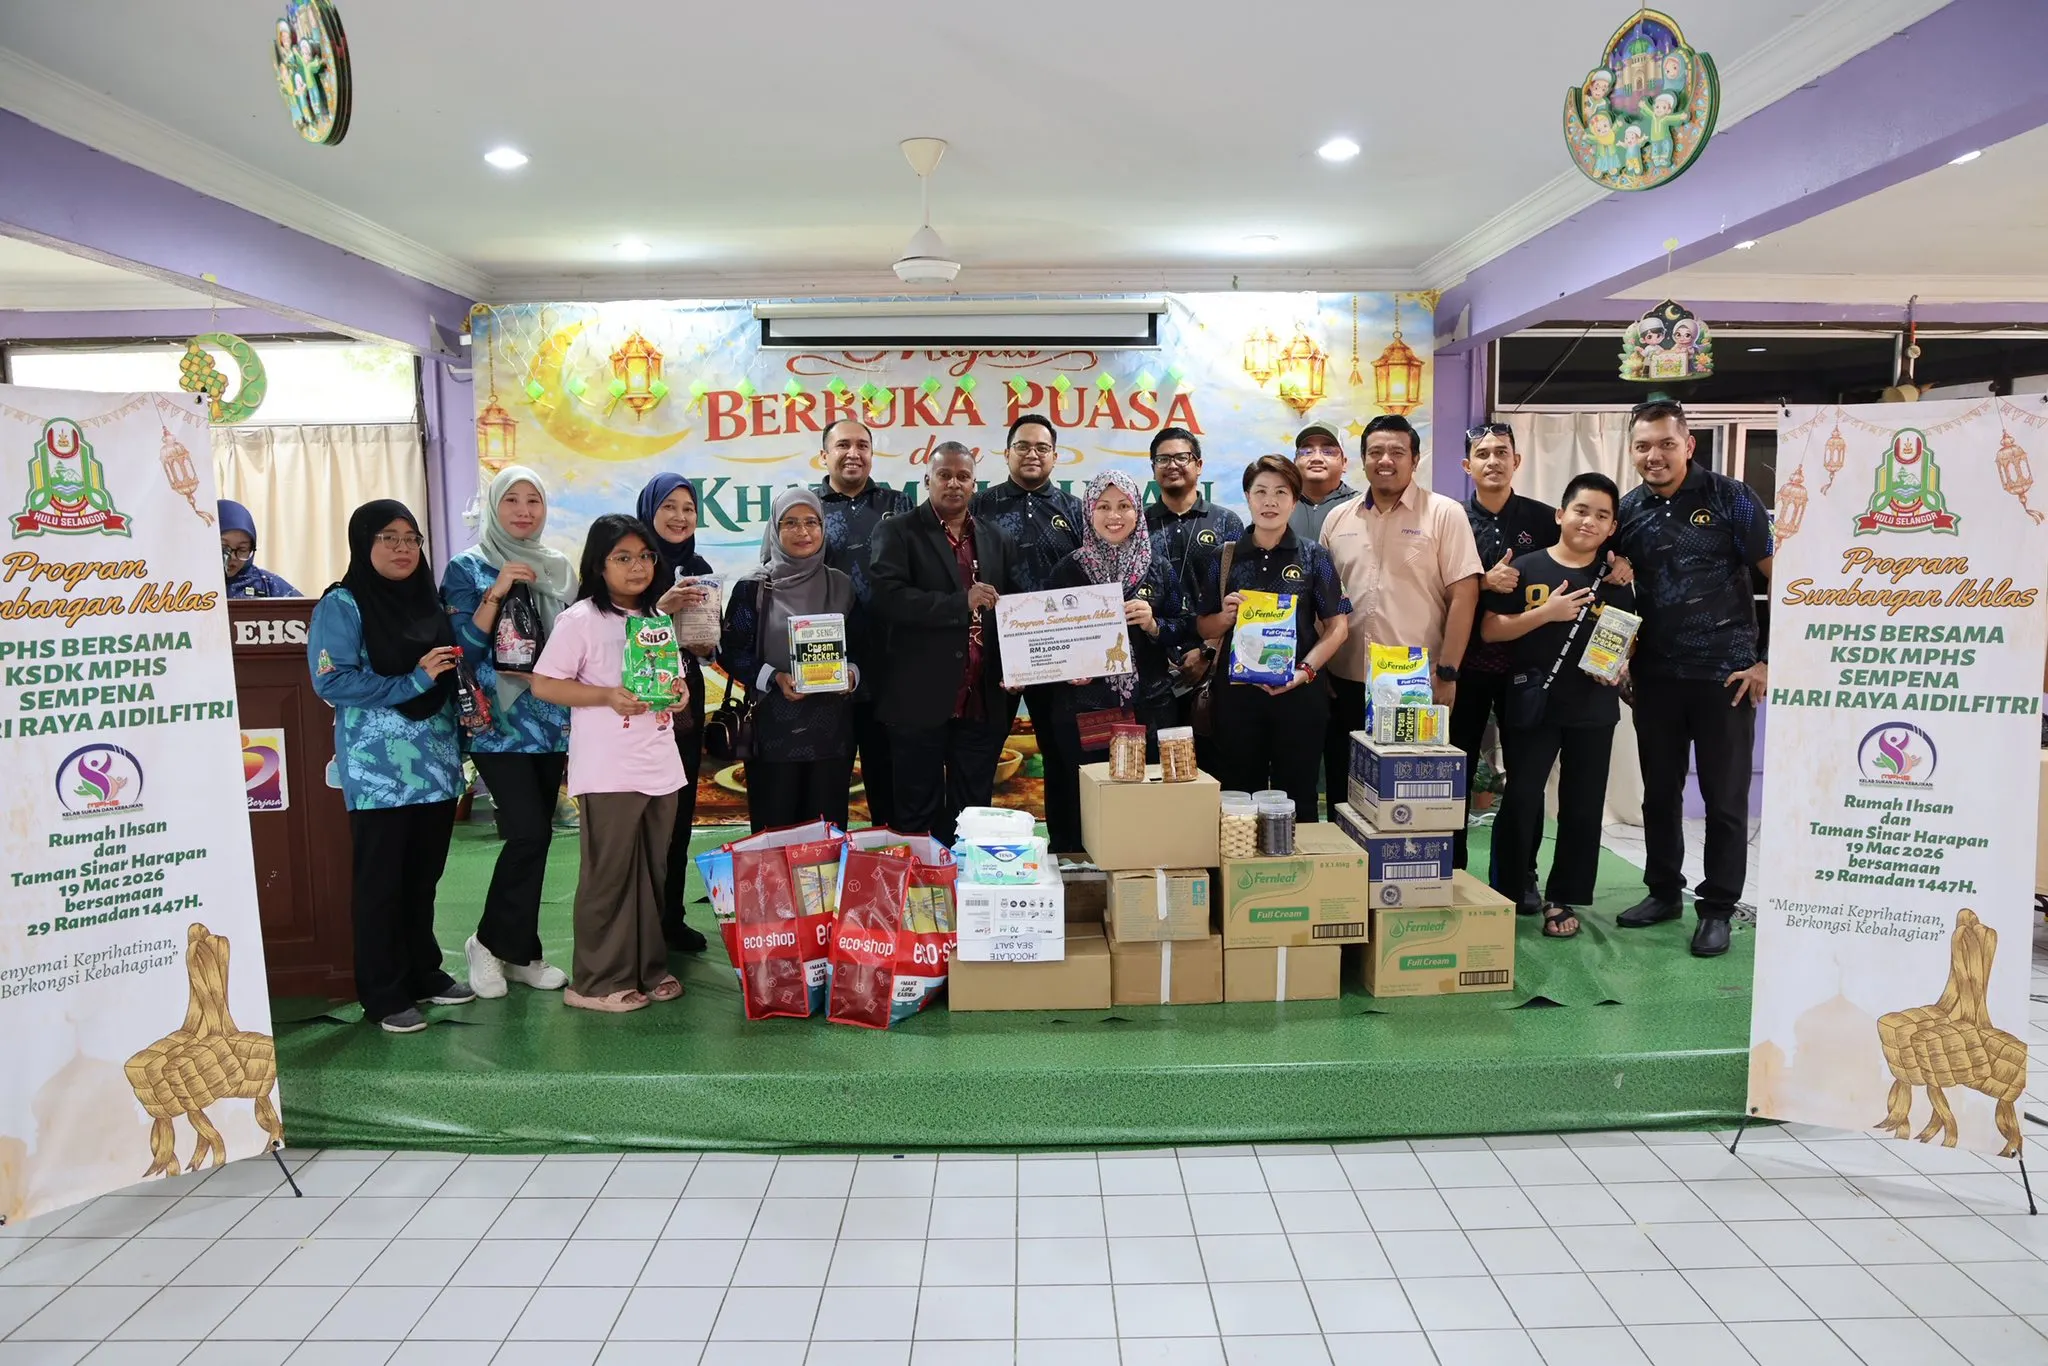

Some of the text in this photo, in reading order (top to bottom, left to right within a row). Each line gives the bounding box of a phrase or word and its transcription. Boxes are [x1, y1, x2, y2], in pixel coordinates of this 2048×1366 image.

[703, 381, 1205, 442] BERBUKA PUASA
[34, 512, 107, 526] HULU SELANGOR
[1873, 512, 1938, 525] HULU SELANGOR
[2, 551, 147, 592] Program
[1286, 569, 1300, 578] 40
[1842, 546, 1968, 583] Program
[128, 582, 218, 613] Ikhlas
[1782, 578, 2038, 616] Sumbangan Ikhlas
[1008, 616, 1044, 631] Program
[1255, 609, 1285, 618] Fernleaf
[234, 620, 309, 645] EHS
[1600, 629, 1623, 644] Cream
[1804, 624, 2004, 644] MPHS BERSAMA
[62, 632, 192, 658] BERSAMA
[808, 643, 834, 652] Cream
[1042, 643, 1070, 651] 3,000.00
[1592, 634, 1624, 654] Crackers
[802, 652, 840, 662] Crackers
[1388, 661, 1417, 670] Fernleaf
[1830, 647, 1976, 666] KSDK MPHS
[6, 657, 168, 686] KSDK MPHS
[1839, 669, 1960, 689] SEMPENA
[20, 682, 155, 711] SEMPENA
[1772, 688, 2038, 714] HARI RAYA AIDILFITRI
[20, 712, 94, 737] RAYA
[98, 700, 234, 730] AIDILFITRI
[1396, 712, 1405, 736] Cream
[1404, 708, 1414, 742] Crackers
[114, 803, 143, 811] KEBAJIKAN
[1844, 794, 1954, 815] Rumah Ihsan
[1880, 812, 1911, 826] dan
[49, 820, 167, 848] Rumah Ihsan
[1809, 822, 1989, 850] Taman Sinar Harapan
[94, 842, 126, 858] dan
[1846, 842, 1944, 860] 19 Mac 2026
[11, 848, 207, 887] Taman Sinar Harapan
[1848, 854, 1940, 875] bersamaan
[59, 869, 165, 898] 19 Mac 2026
[1254, 872, 1297, 884] Fernleaf
[1815, 869, 1977, 894] 29 Ramadan 1447H.
[65, 886, 163, 913] bersamaan
[27, 894, 203, 937] 29 Ramadan 1447H.
[1257, 910, 1272, 919] Full
[1785, 915, 1851, 935] Berkongsi
[1847, 904, 1944, 928] Keprihatinan,
[1406, 920, 1446, 932] Fernleaf
[74, 939, 177, 968] Keprihatinan,
[995, 942, 1014, 950] SALT
[1407, 958, 1449, 966] Full Cream
[1, 970, 79, 1000] Berkongsi
